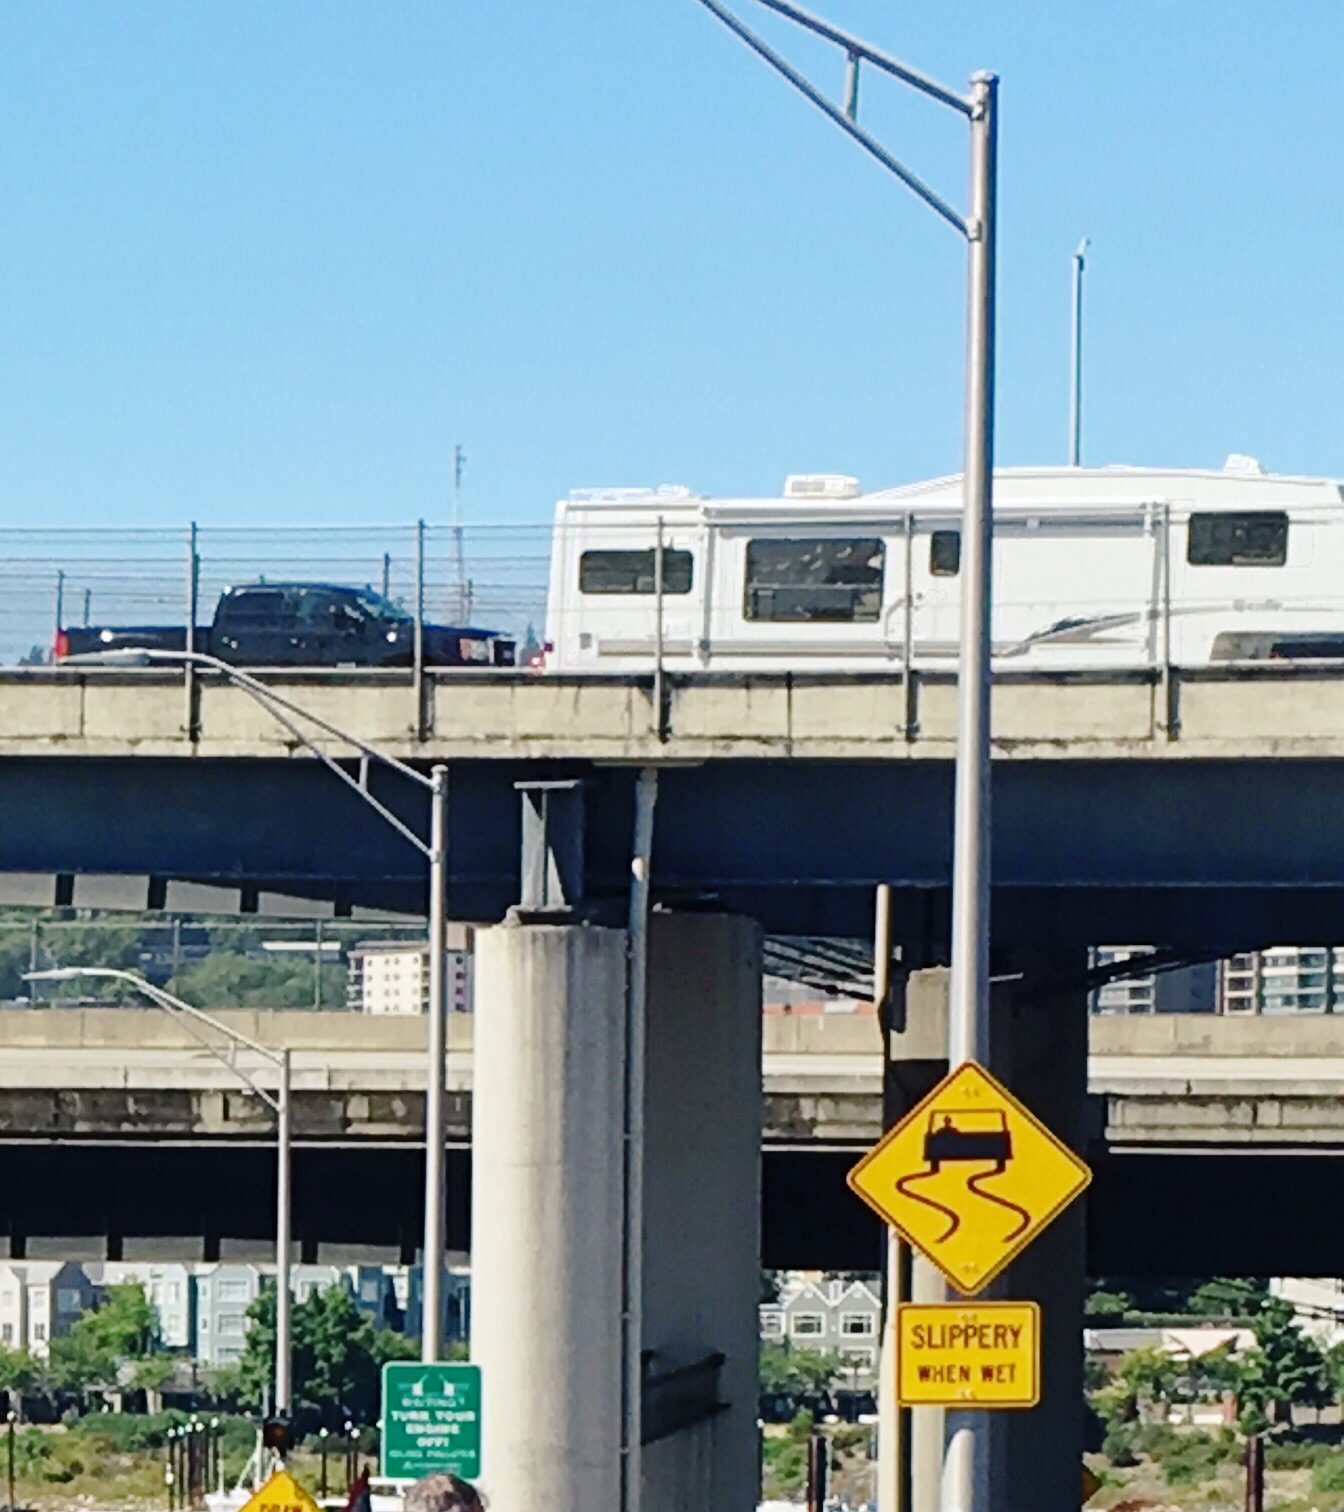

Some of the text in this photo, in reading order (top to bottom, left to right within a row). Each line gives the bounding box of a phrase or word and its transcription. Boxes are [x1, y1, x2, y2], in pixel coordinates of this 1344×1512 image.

[911, 1324, 1023, 1349] SLIPPERY
[917, 1362, 1016, 1384] WHEN WET
